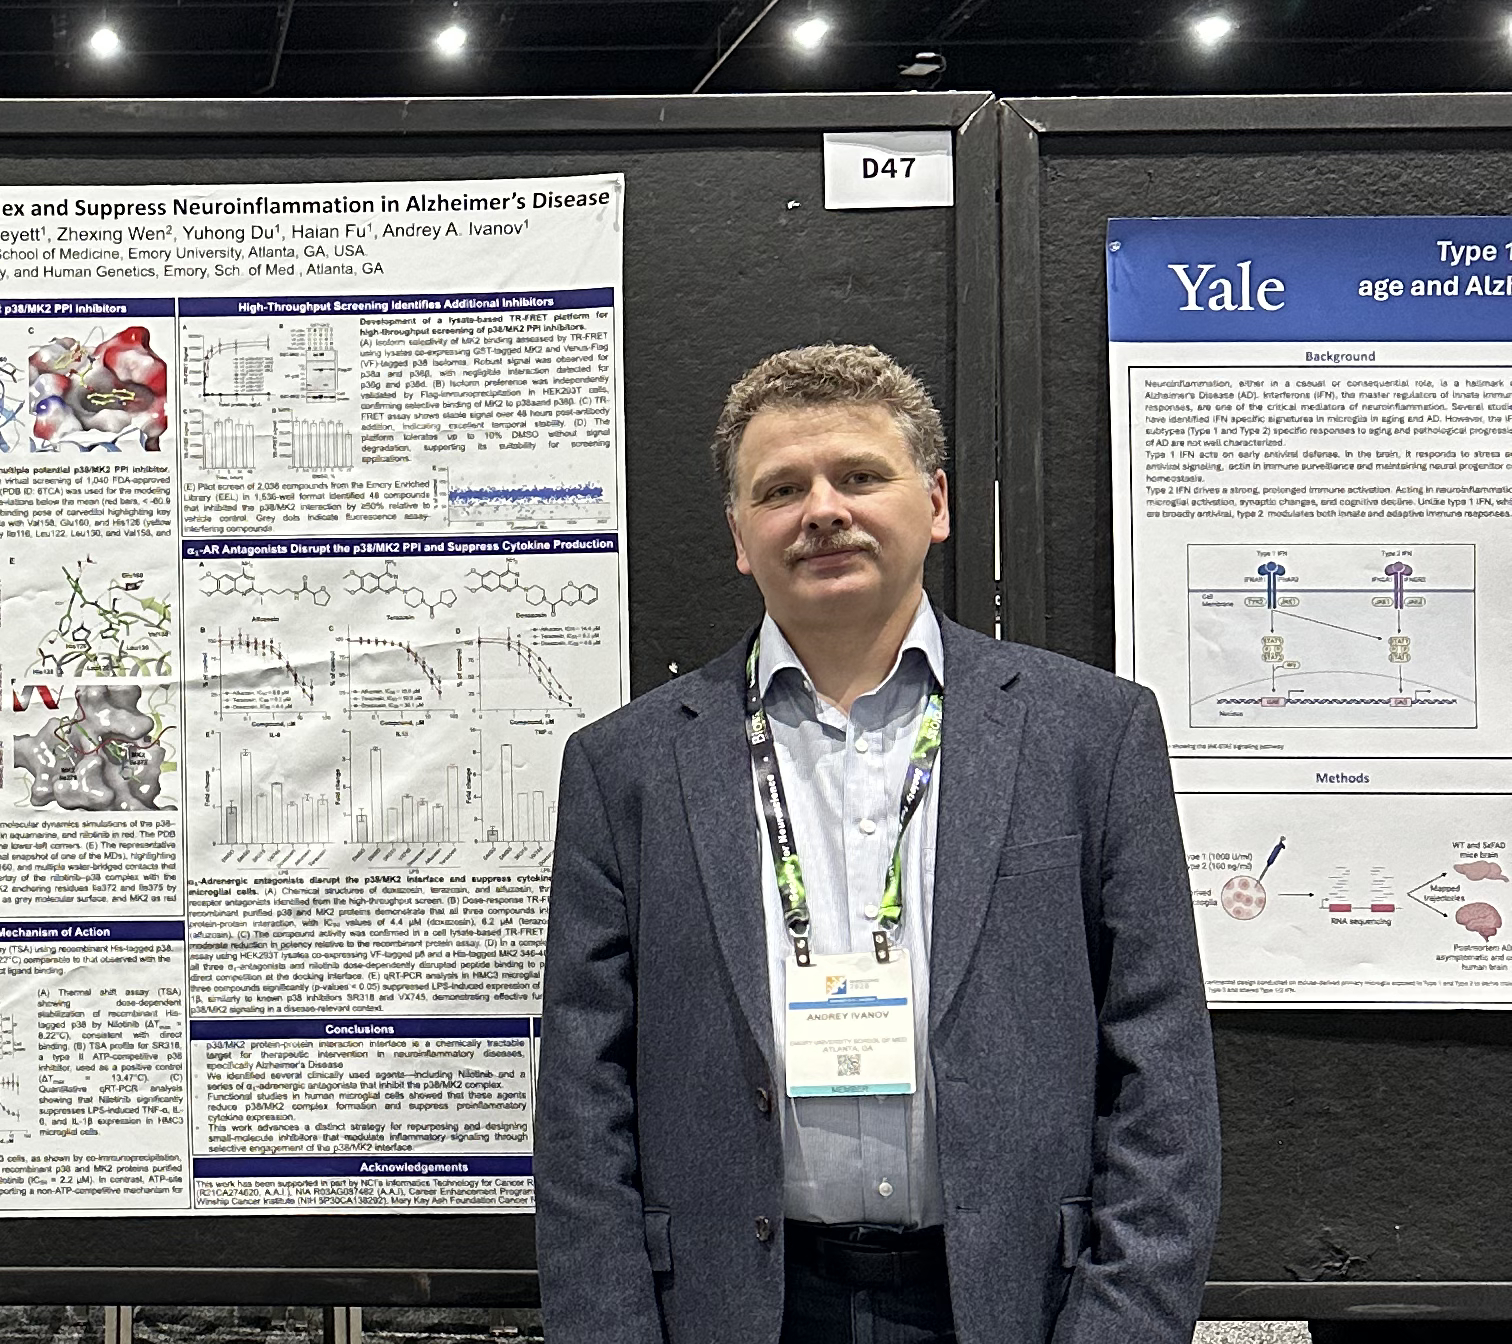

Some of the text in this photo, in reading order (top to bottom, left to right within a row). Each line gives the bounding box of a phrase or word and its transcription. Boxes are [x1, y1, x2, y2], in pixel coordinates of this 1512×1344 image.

[862, 157, 916, 179] D47
[30, 198, 69, 217] and
[74, 199, 167, 221] Suppress
[173, 195, 374, 216] Neuroinflammation
[380, 195, 400, 213] in
[532, 191, 610, 209] Disease
[57, 226, 123, 245] Zhexing
[183, 225, 245, 244] Yuhong
[382, 222, 442, 241] Andrey
[42, 247, 57, 260] of
[59, 247, 123, 261] Medicine,
[128, 247, 172, 263] Emory
[176, 246, 245, 262] University,
[303, 244, 329, 258] GA,
[1436, 240, 1498, 267] Type
[13, 265, 39, 278] and
[43, 265, 92, 278] Human
[96, 265, 159, 279] Genetics,
[163, 264, 210, 280] Emory,
[248, 263, 262, 277] of
[305, 263, 357, 276] Atlanta,
[361, 261, 385, 275] GA
[1167, 260, 1286, 312] Yale
[1358, 278, 1404, 302] age
[1410, 275, 1459, 297] and
[5, 303, 51, 316] p38/MK2
[54, 303, 73, 314] PPI
[75, 303, 127, 314] Inhibitors
[238, 296, 555, 315] High-Throughput Screening Identifies Additional Inhibitors
[1305, 350, 1376, 364] Background
[222, 543, 287, 557] Antagonists
[290, 543, 331, 556] Disrupt
[333, 543, 351, 554] the
[353, 542, 399, 555] p38/MK2
[403, 542, 421, 553] PPI
[423, 541, 445, 552] and
[447, 541, 500, 554] Suppress
[502, 539, 550, 553] Cytokine
[553, 538, 614, 550] Production
[1316, 771, 1370, 784] Methods
[61, 926, 73, 937] of
[74, 926, 111, 937] Action
[806, 1011, 890, 1021] ANDREY IVANOV
[325, 1024, 395, 1035] Conclusions
[359, 1161, 469, 1175] Acknowledgements
